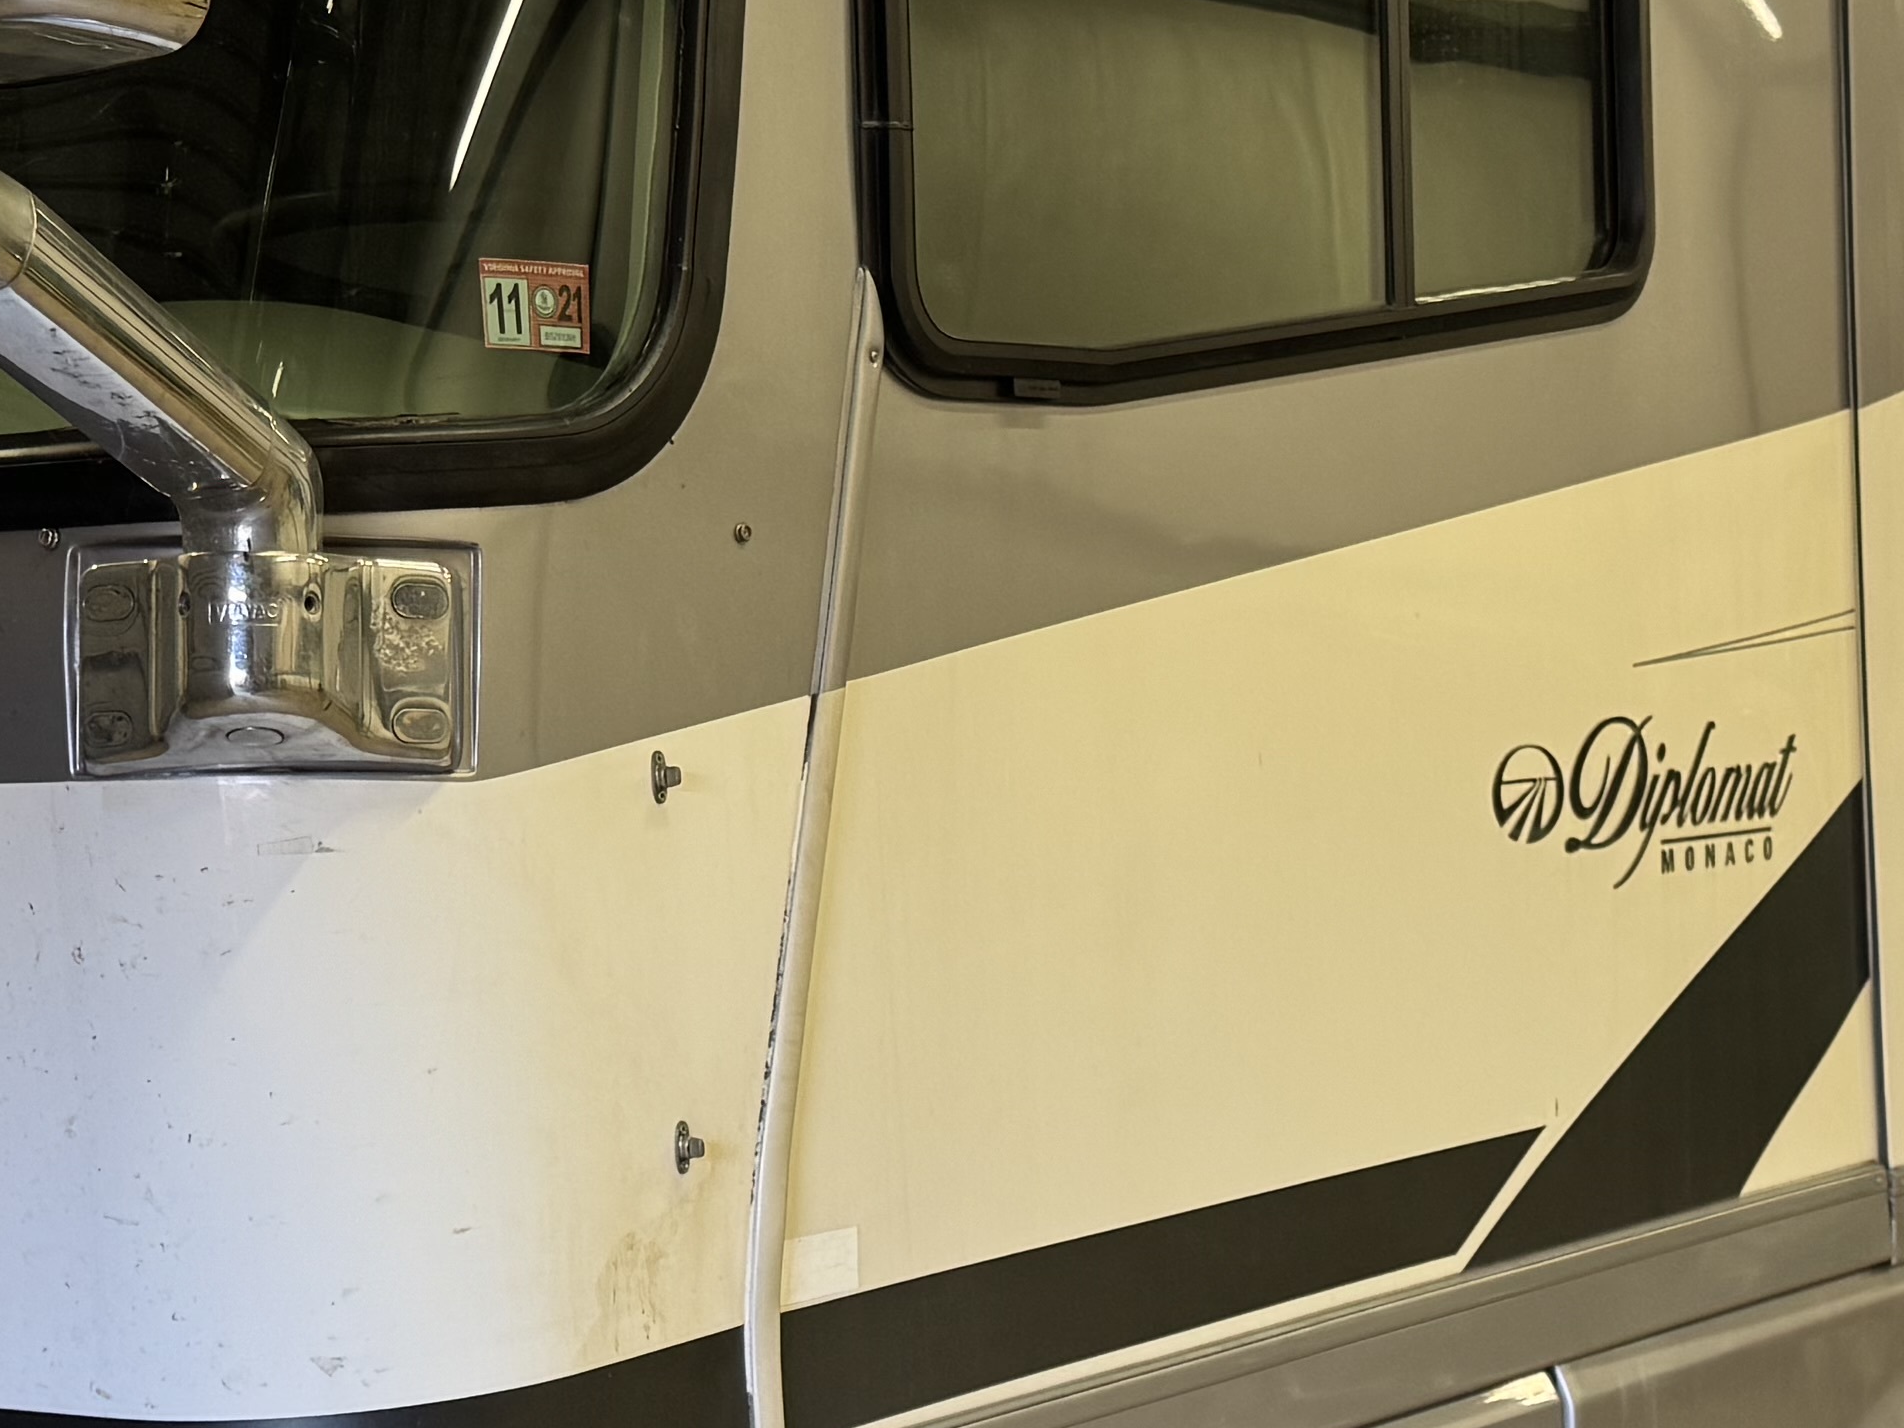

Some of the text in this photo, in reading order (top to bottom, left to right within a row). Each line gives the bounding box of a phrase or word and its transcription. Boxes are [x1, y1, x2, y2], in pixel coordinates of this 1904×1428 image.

[489, 282, 523, 335] 11
[558, 284, 583, 323] 21
[1564, 714, 1797, 890] Diplomat
[1660, 835, 1774, 875] MONACO
